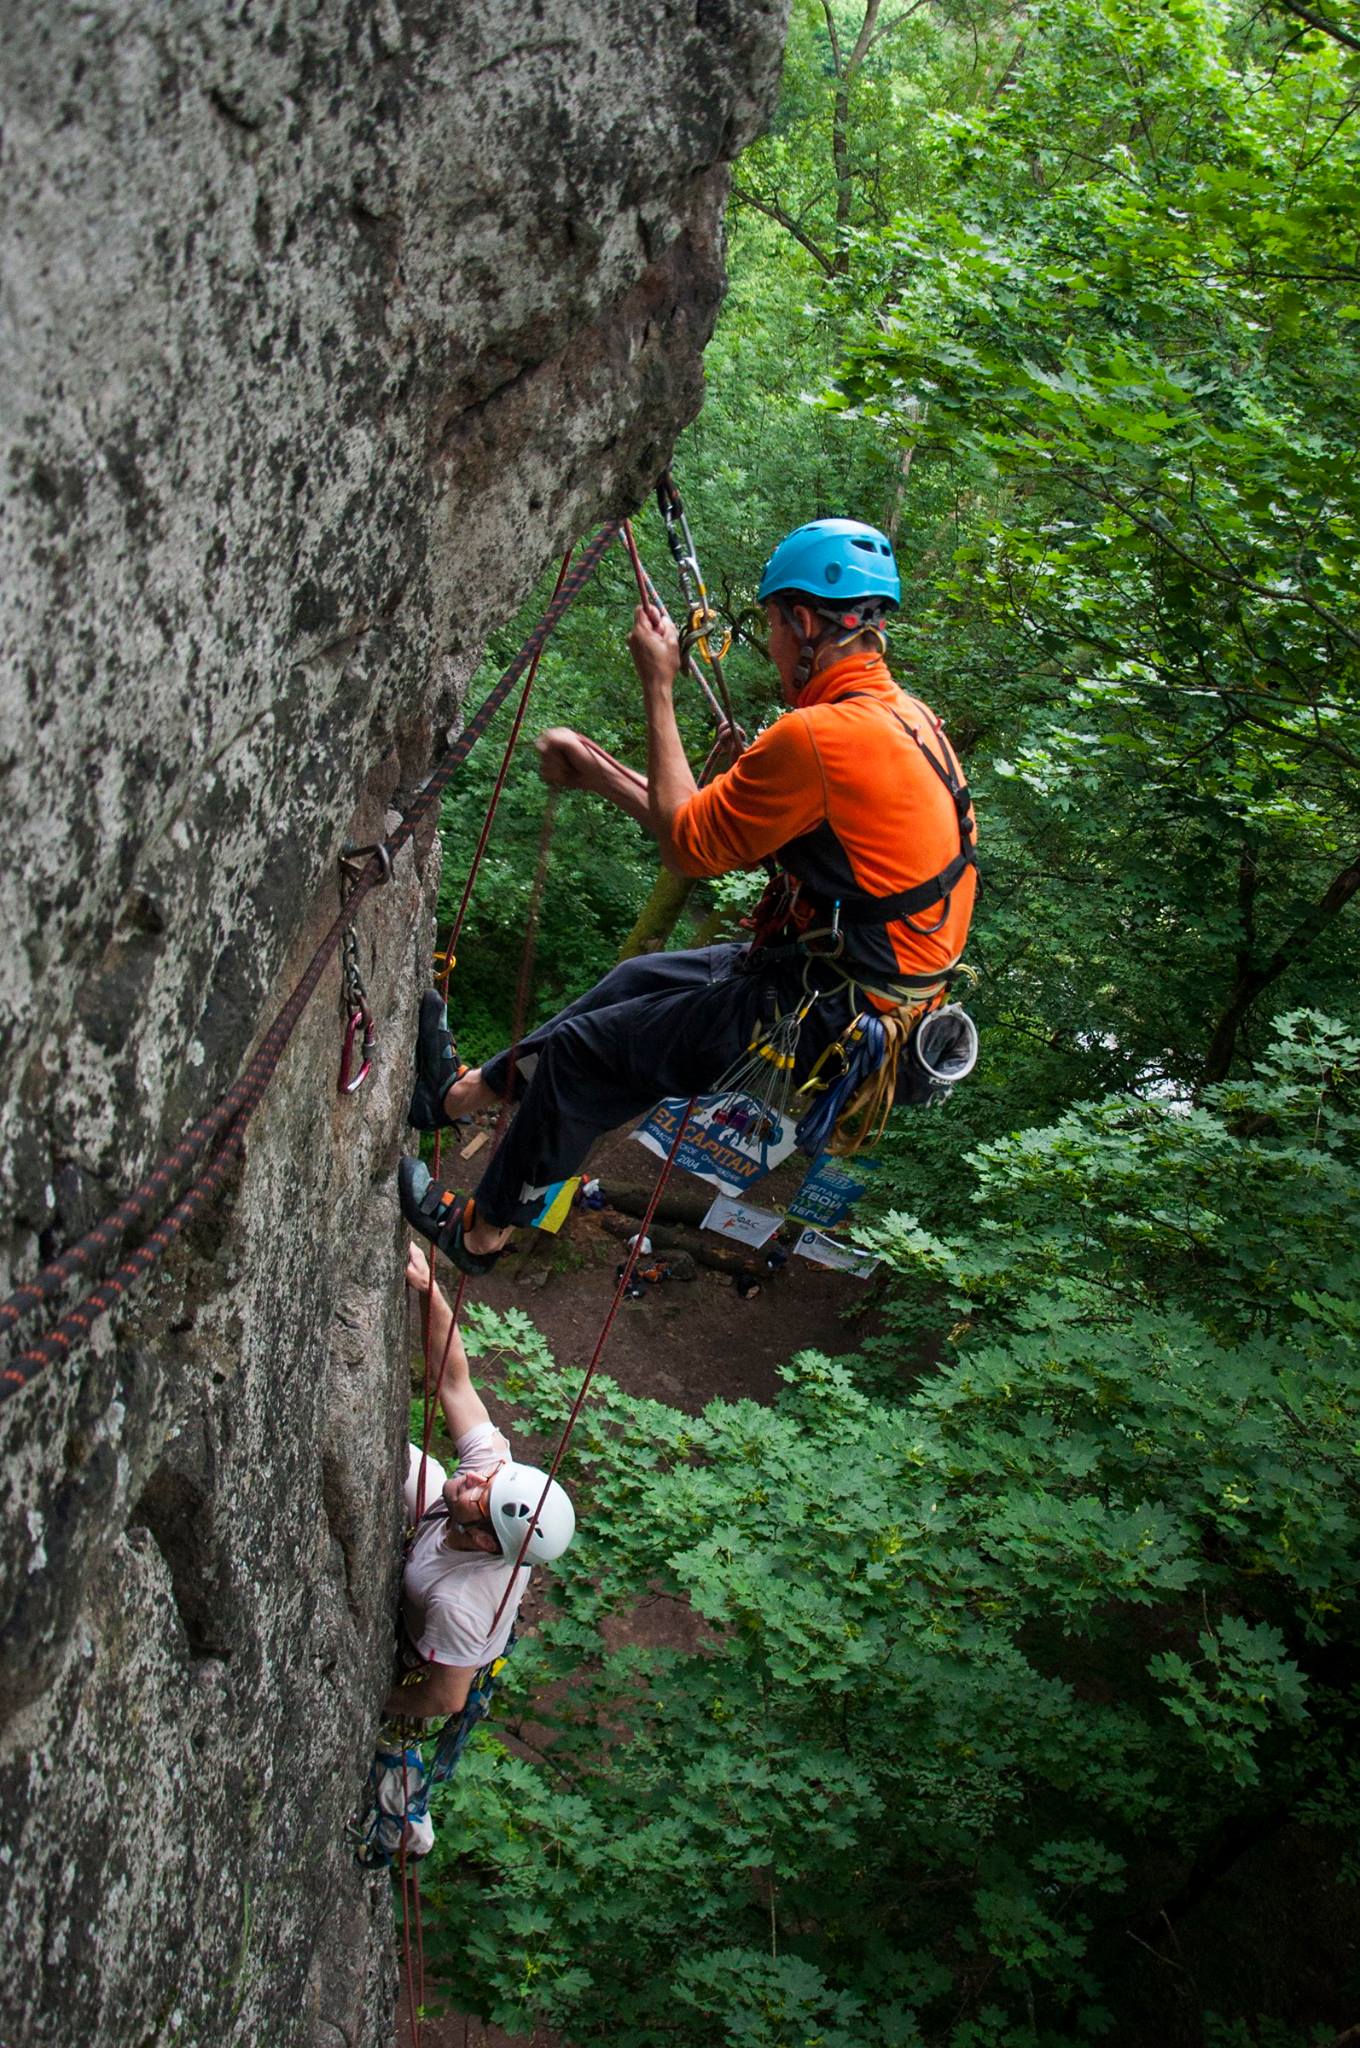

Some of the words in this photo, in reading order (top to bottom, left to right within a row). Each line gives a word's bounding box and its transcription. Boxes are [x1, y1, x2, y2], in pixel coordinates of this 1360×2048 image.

[651, 1107, 677, 1133] EL
[681, 1125, 759, 1177] CAPITAN
[676, 1154, 700, 1170] 2004
